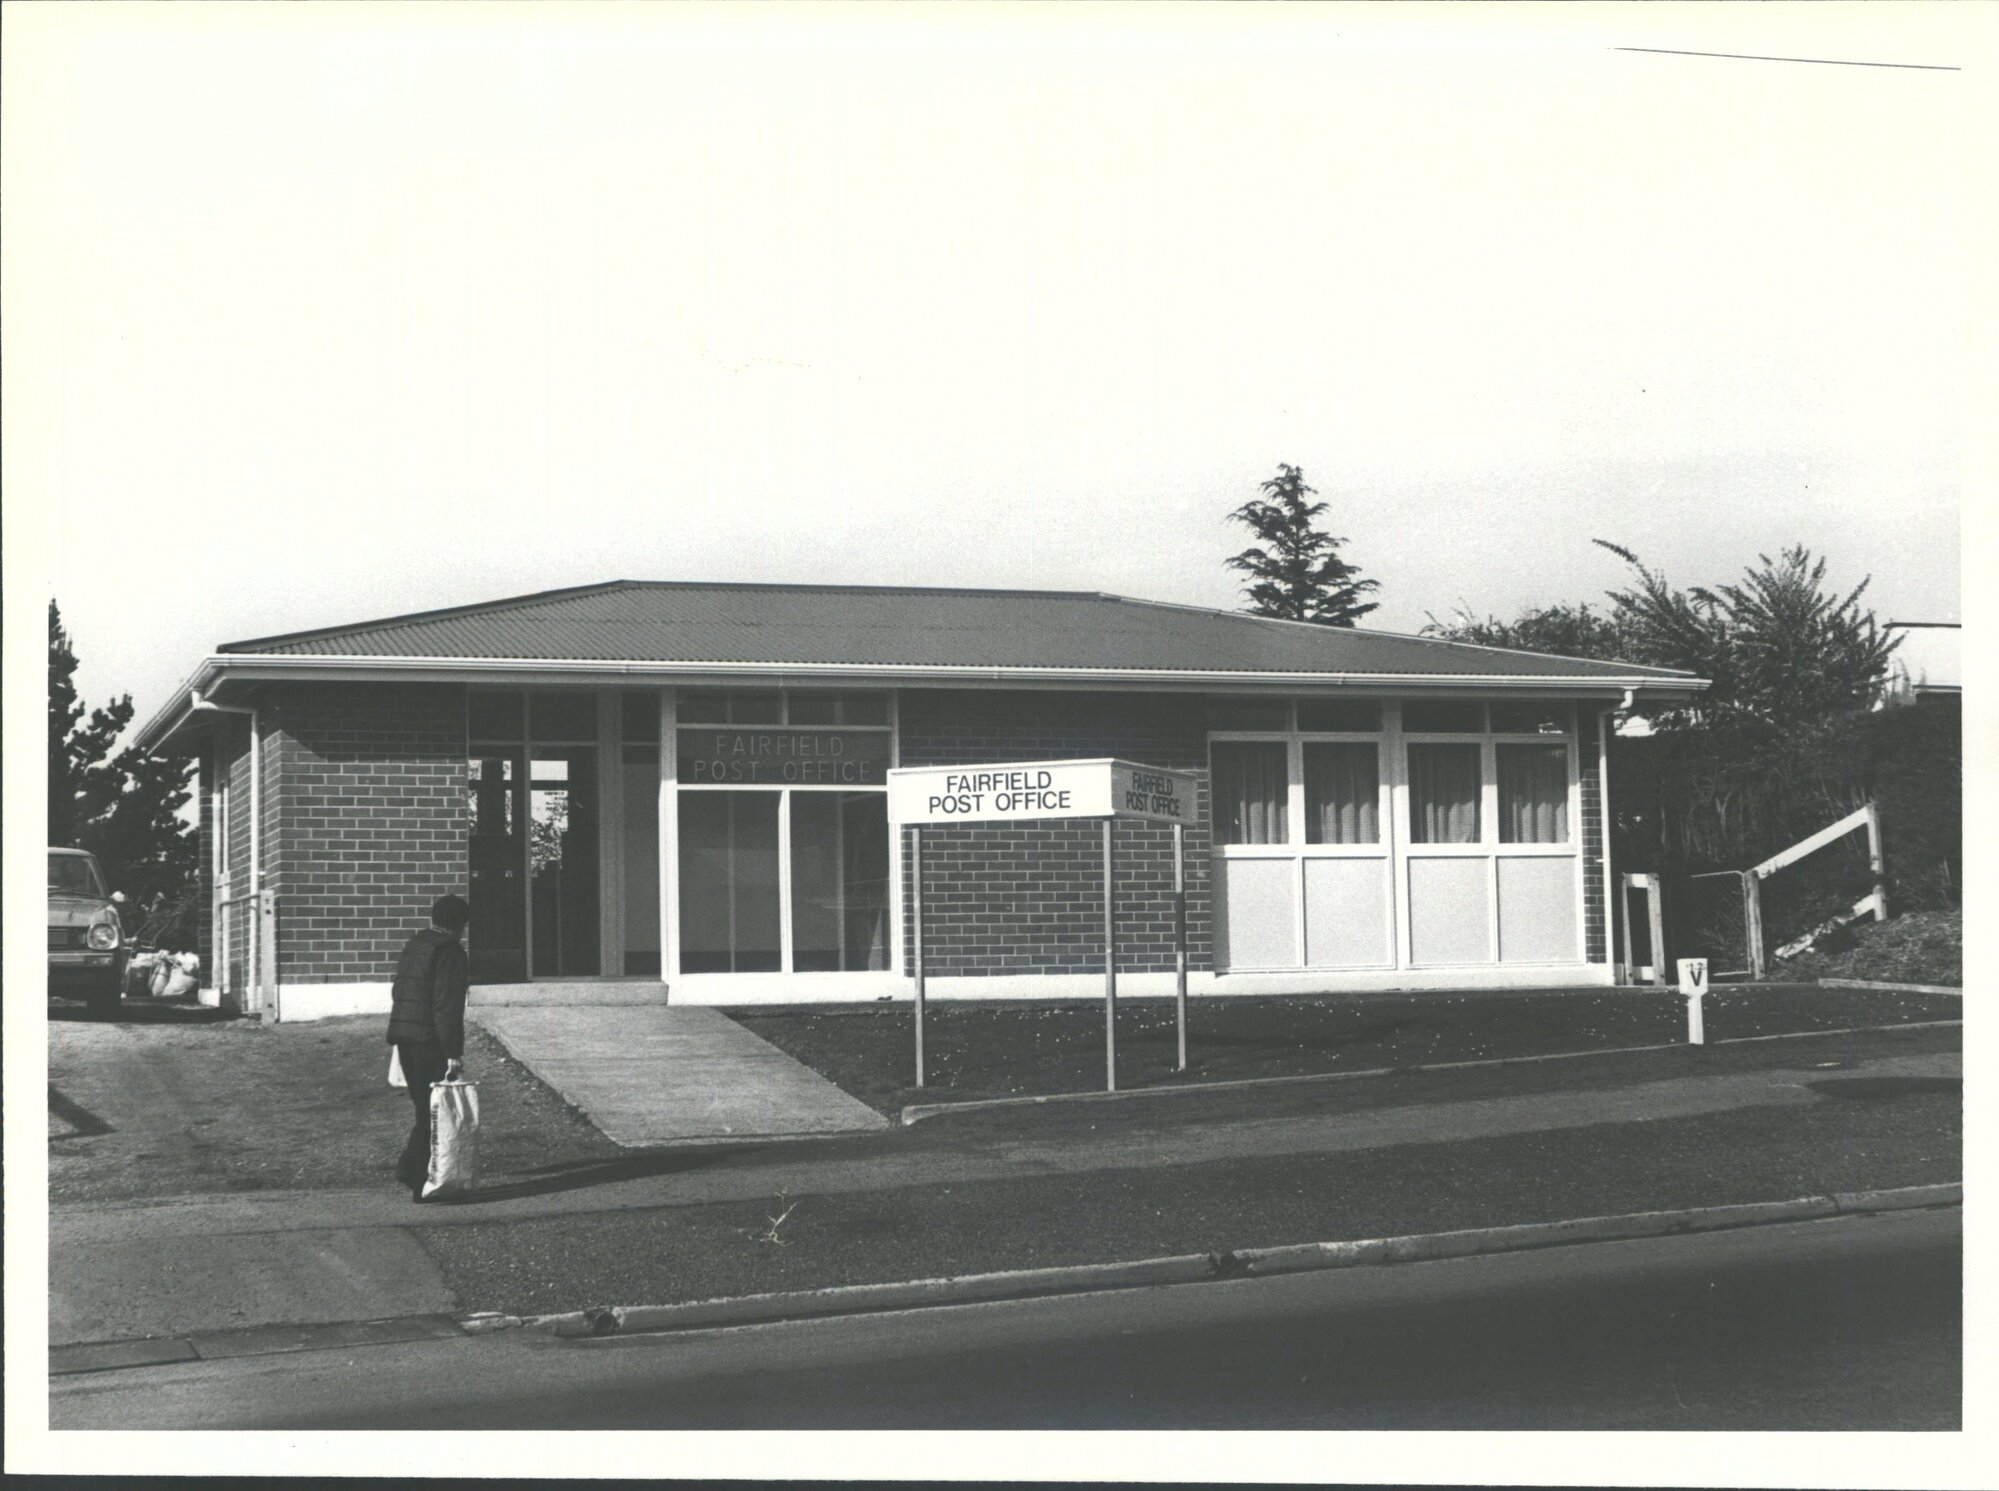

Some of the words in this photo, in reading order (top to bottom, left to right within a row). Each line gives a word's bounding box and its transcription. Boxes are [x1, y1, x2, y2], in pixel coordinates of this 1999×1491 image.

[715, 735, 845, 757] FAIRFIELD
[694, 760, 761, 781] POST
[782, 761, 871, 782] OFFICE
[946, 771, 1053, 794] FAIRFIELD
[1132, 771, 1174, 797] FAIRFIELD
[929, 794, 985, 814] POST
[995, 790, 1071, 812] OFFICE
[1125, 790, 1149, 813] POST
[1151, 794, 1181, 817] OFFICE
[1690, 970, 1702, 987] V
